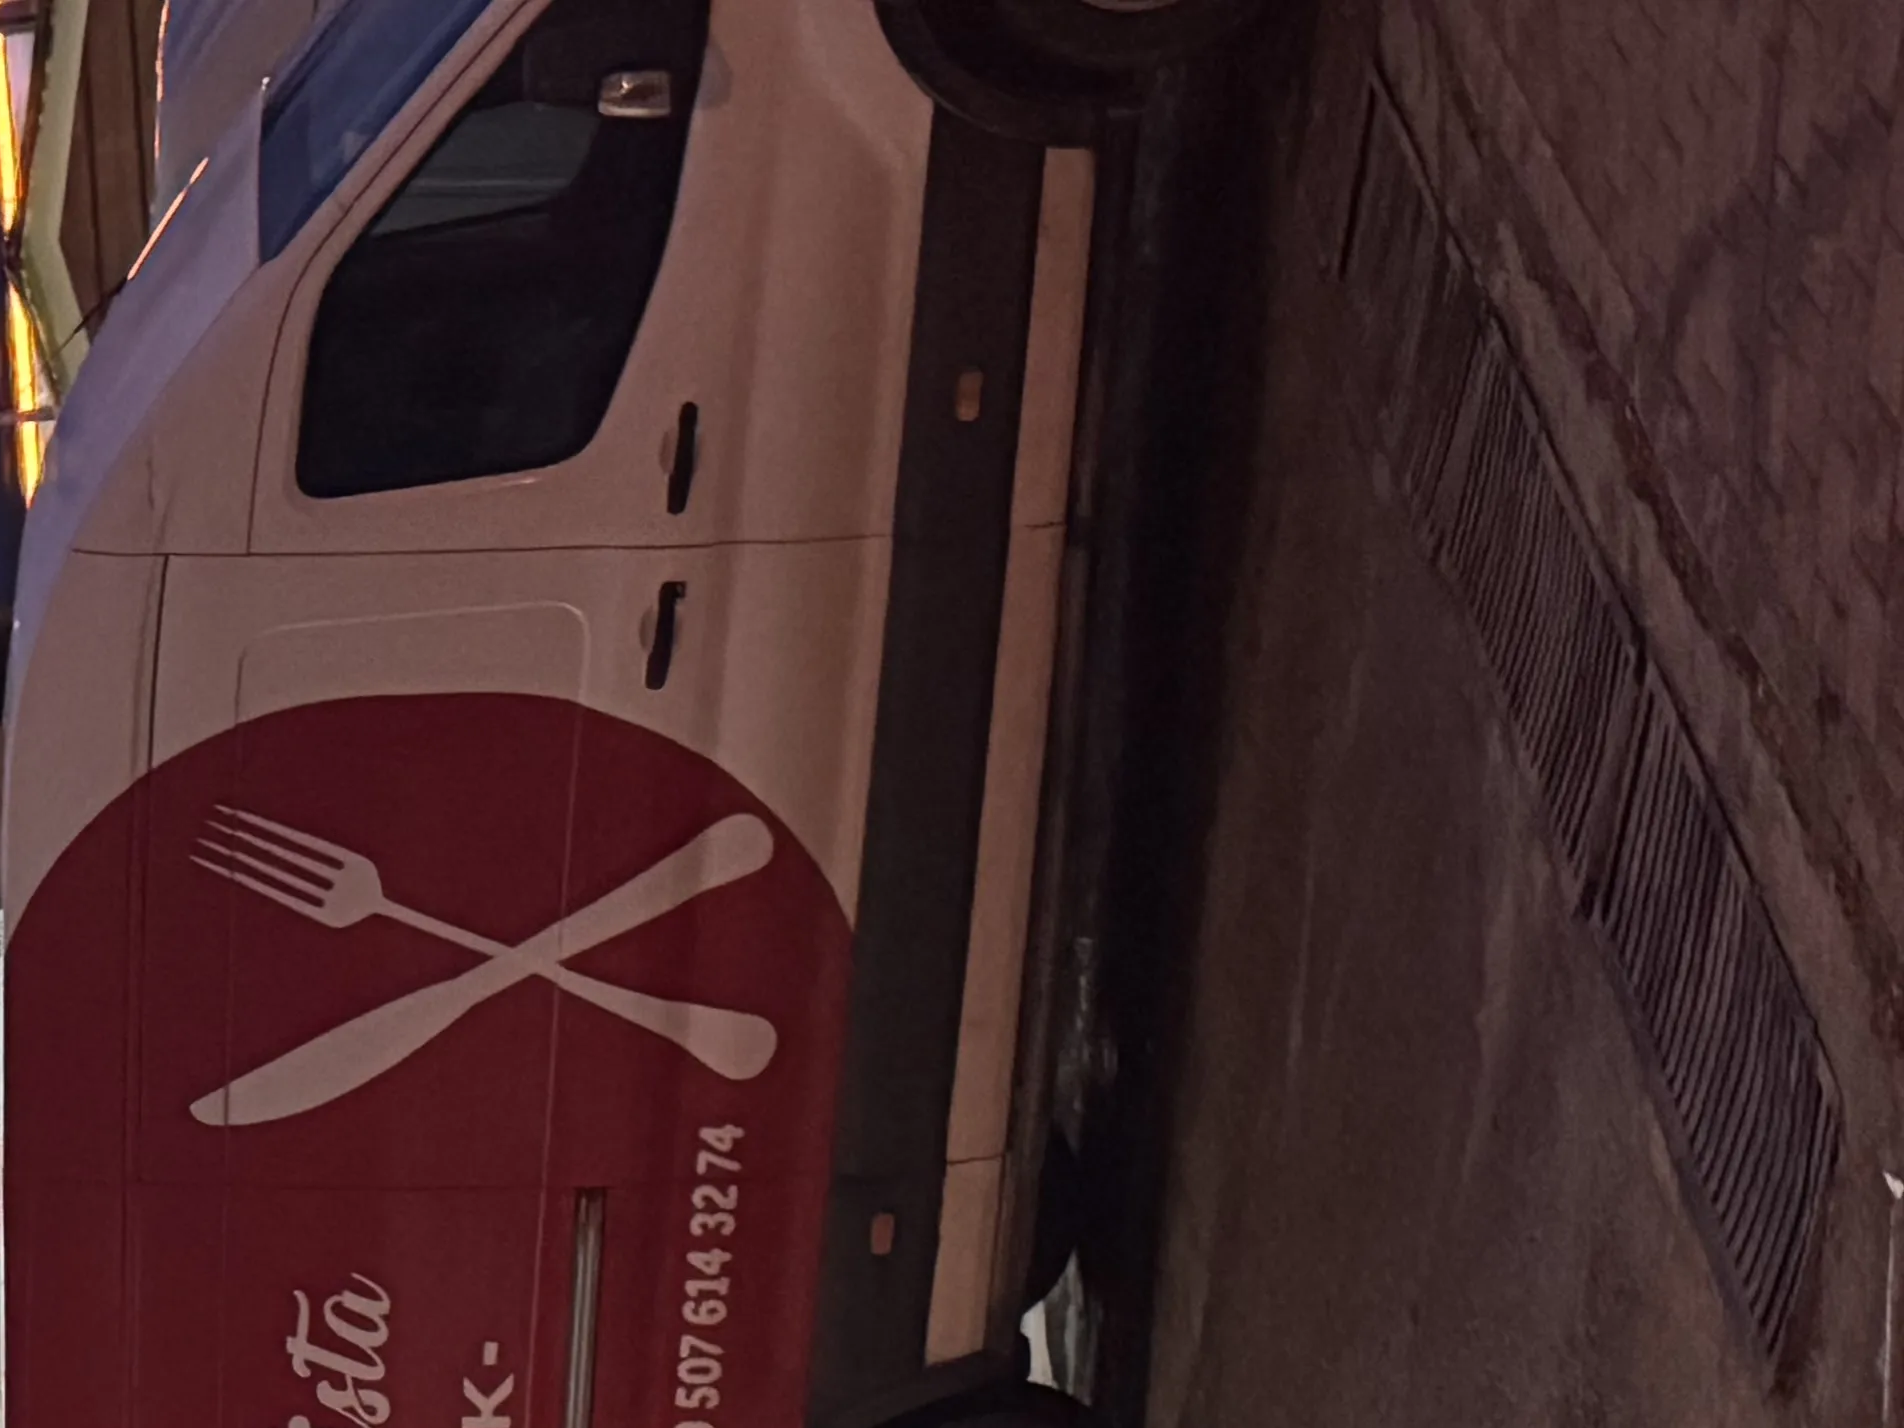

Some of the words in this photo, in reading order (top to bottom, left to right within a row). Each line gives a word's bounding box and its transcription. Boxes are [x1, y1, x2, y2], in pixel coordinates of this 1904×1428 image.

[695, 1125, 745, 1176] 74
[688, 1184, 738, 1237] 32
[681, 1248, 733, 1327] 614
[673, 1335, 723, 1410] 507
